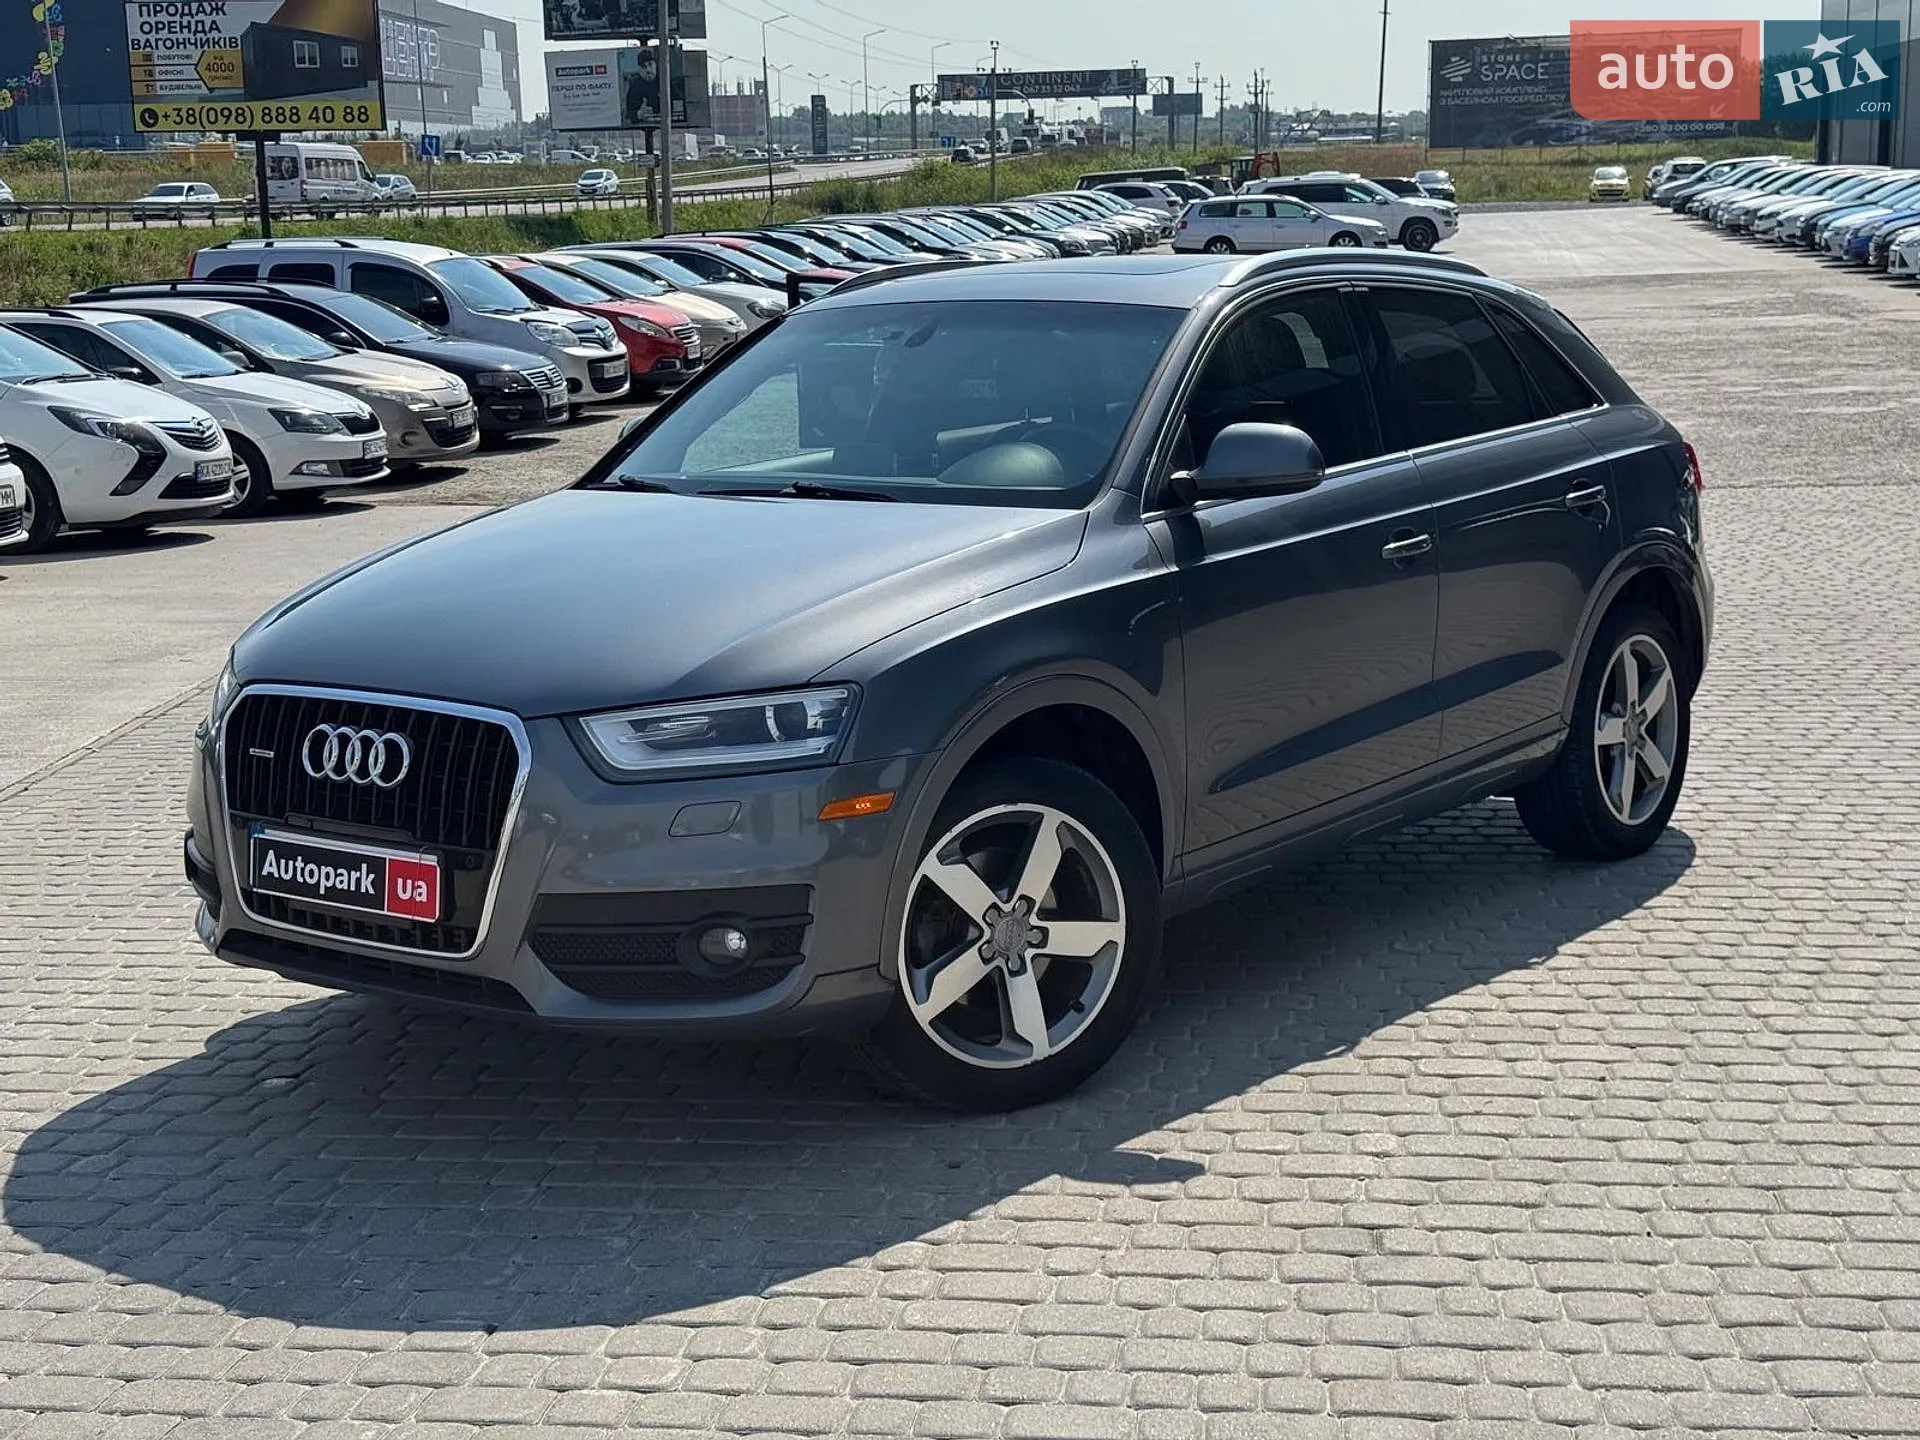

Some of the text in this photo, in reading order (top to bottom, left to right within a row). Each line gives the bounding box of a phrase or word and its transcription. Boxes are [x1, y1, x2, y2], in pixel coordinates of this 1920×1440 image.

[138, 2, 228, 20] ПРОДАЖ
[139, 19, 222, 37] ОРЕНДА
[130, 36, 240, 51] ВАГОНЧИКІВ
[204, 62, 236, 73] 4000
[1480, 62, 1550, 81] SPACE
[1000, 71, 1091, 86] CONTINENT
[162, 105, 371, 130] +38(098) 888 40 88
[261, 849, 429, 903] Autopark ua
